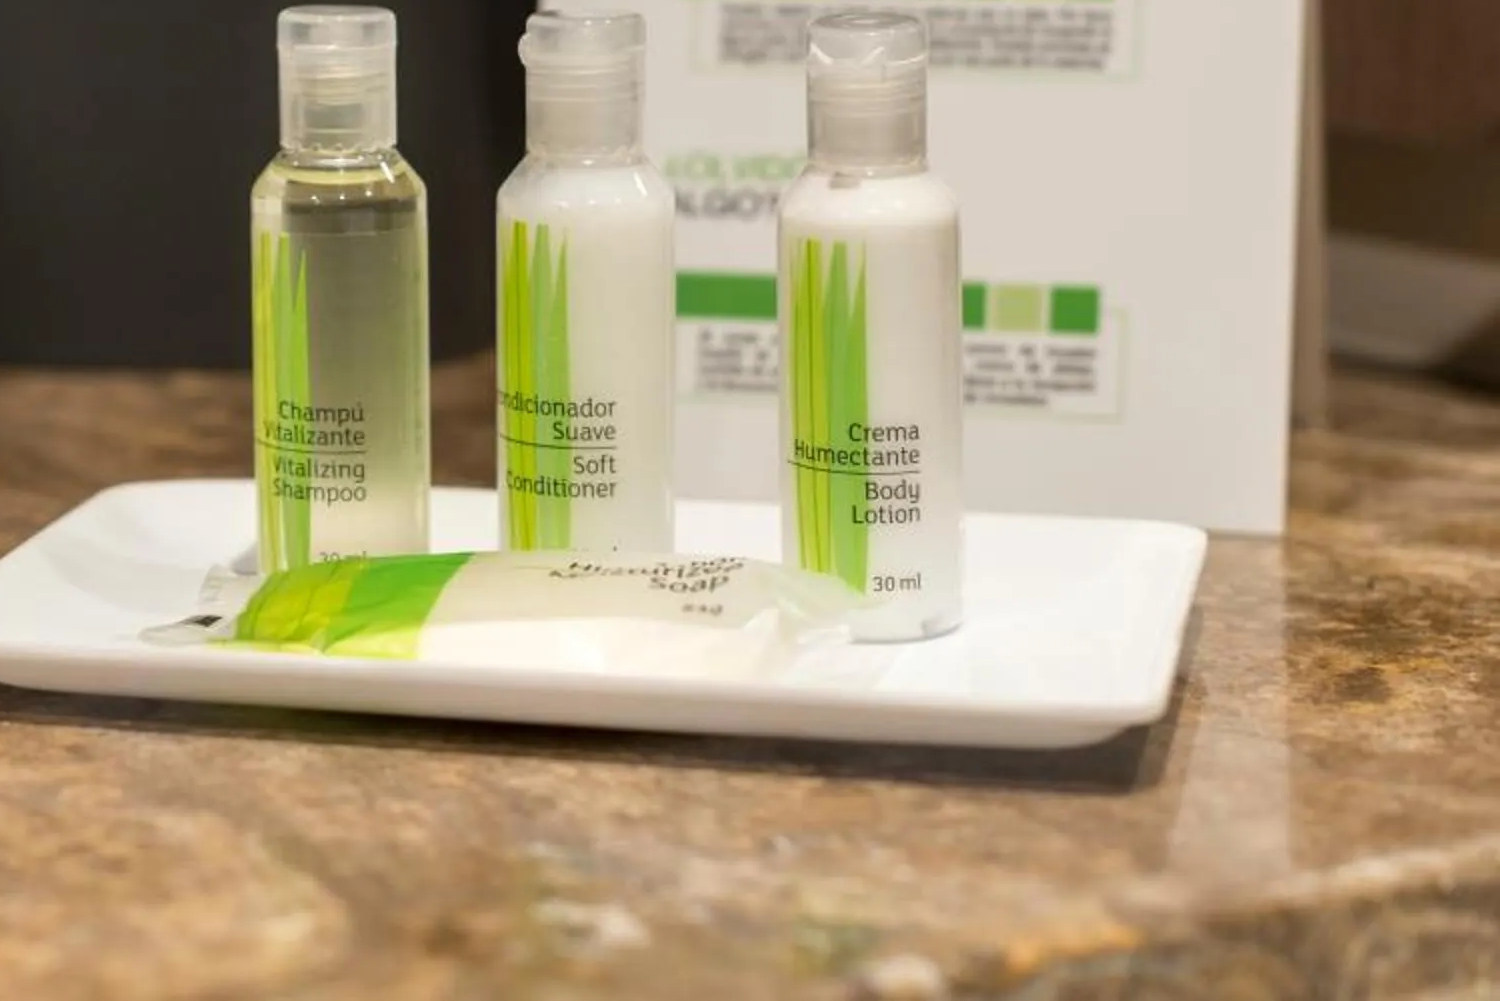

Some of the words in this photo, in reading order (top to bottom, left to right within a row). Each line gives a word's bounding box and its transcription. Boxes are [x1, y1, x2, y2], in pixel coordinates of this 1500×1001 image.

[278, 399, 365, 427] Champú
[552, 420, 617, 441] Suave
[849, 422, 920, 443] Crema
[573, 454, 617, 475] Soft
[793, 438, 920, 466] Humectante
[272, 455, 366, 484] Vitalizing
[272, 478, 367, 508] Shampoo
[505, 470, 617, 498] Conditioner
[864, 479, 921, 504] Body
[851, 503, 922, 525] Lotion
[872, 575, 896, 593] 30
[899, 572, 922, 591] ml
